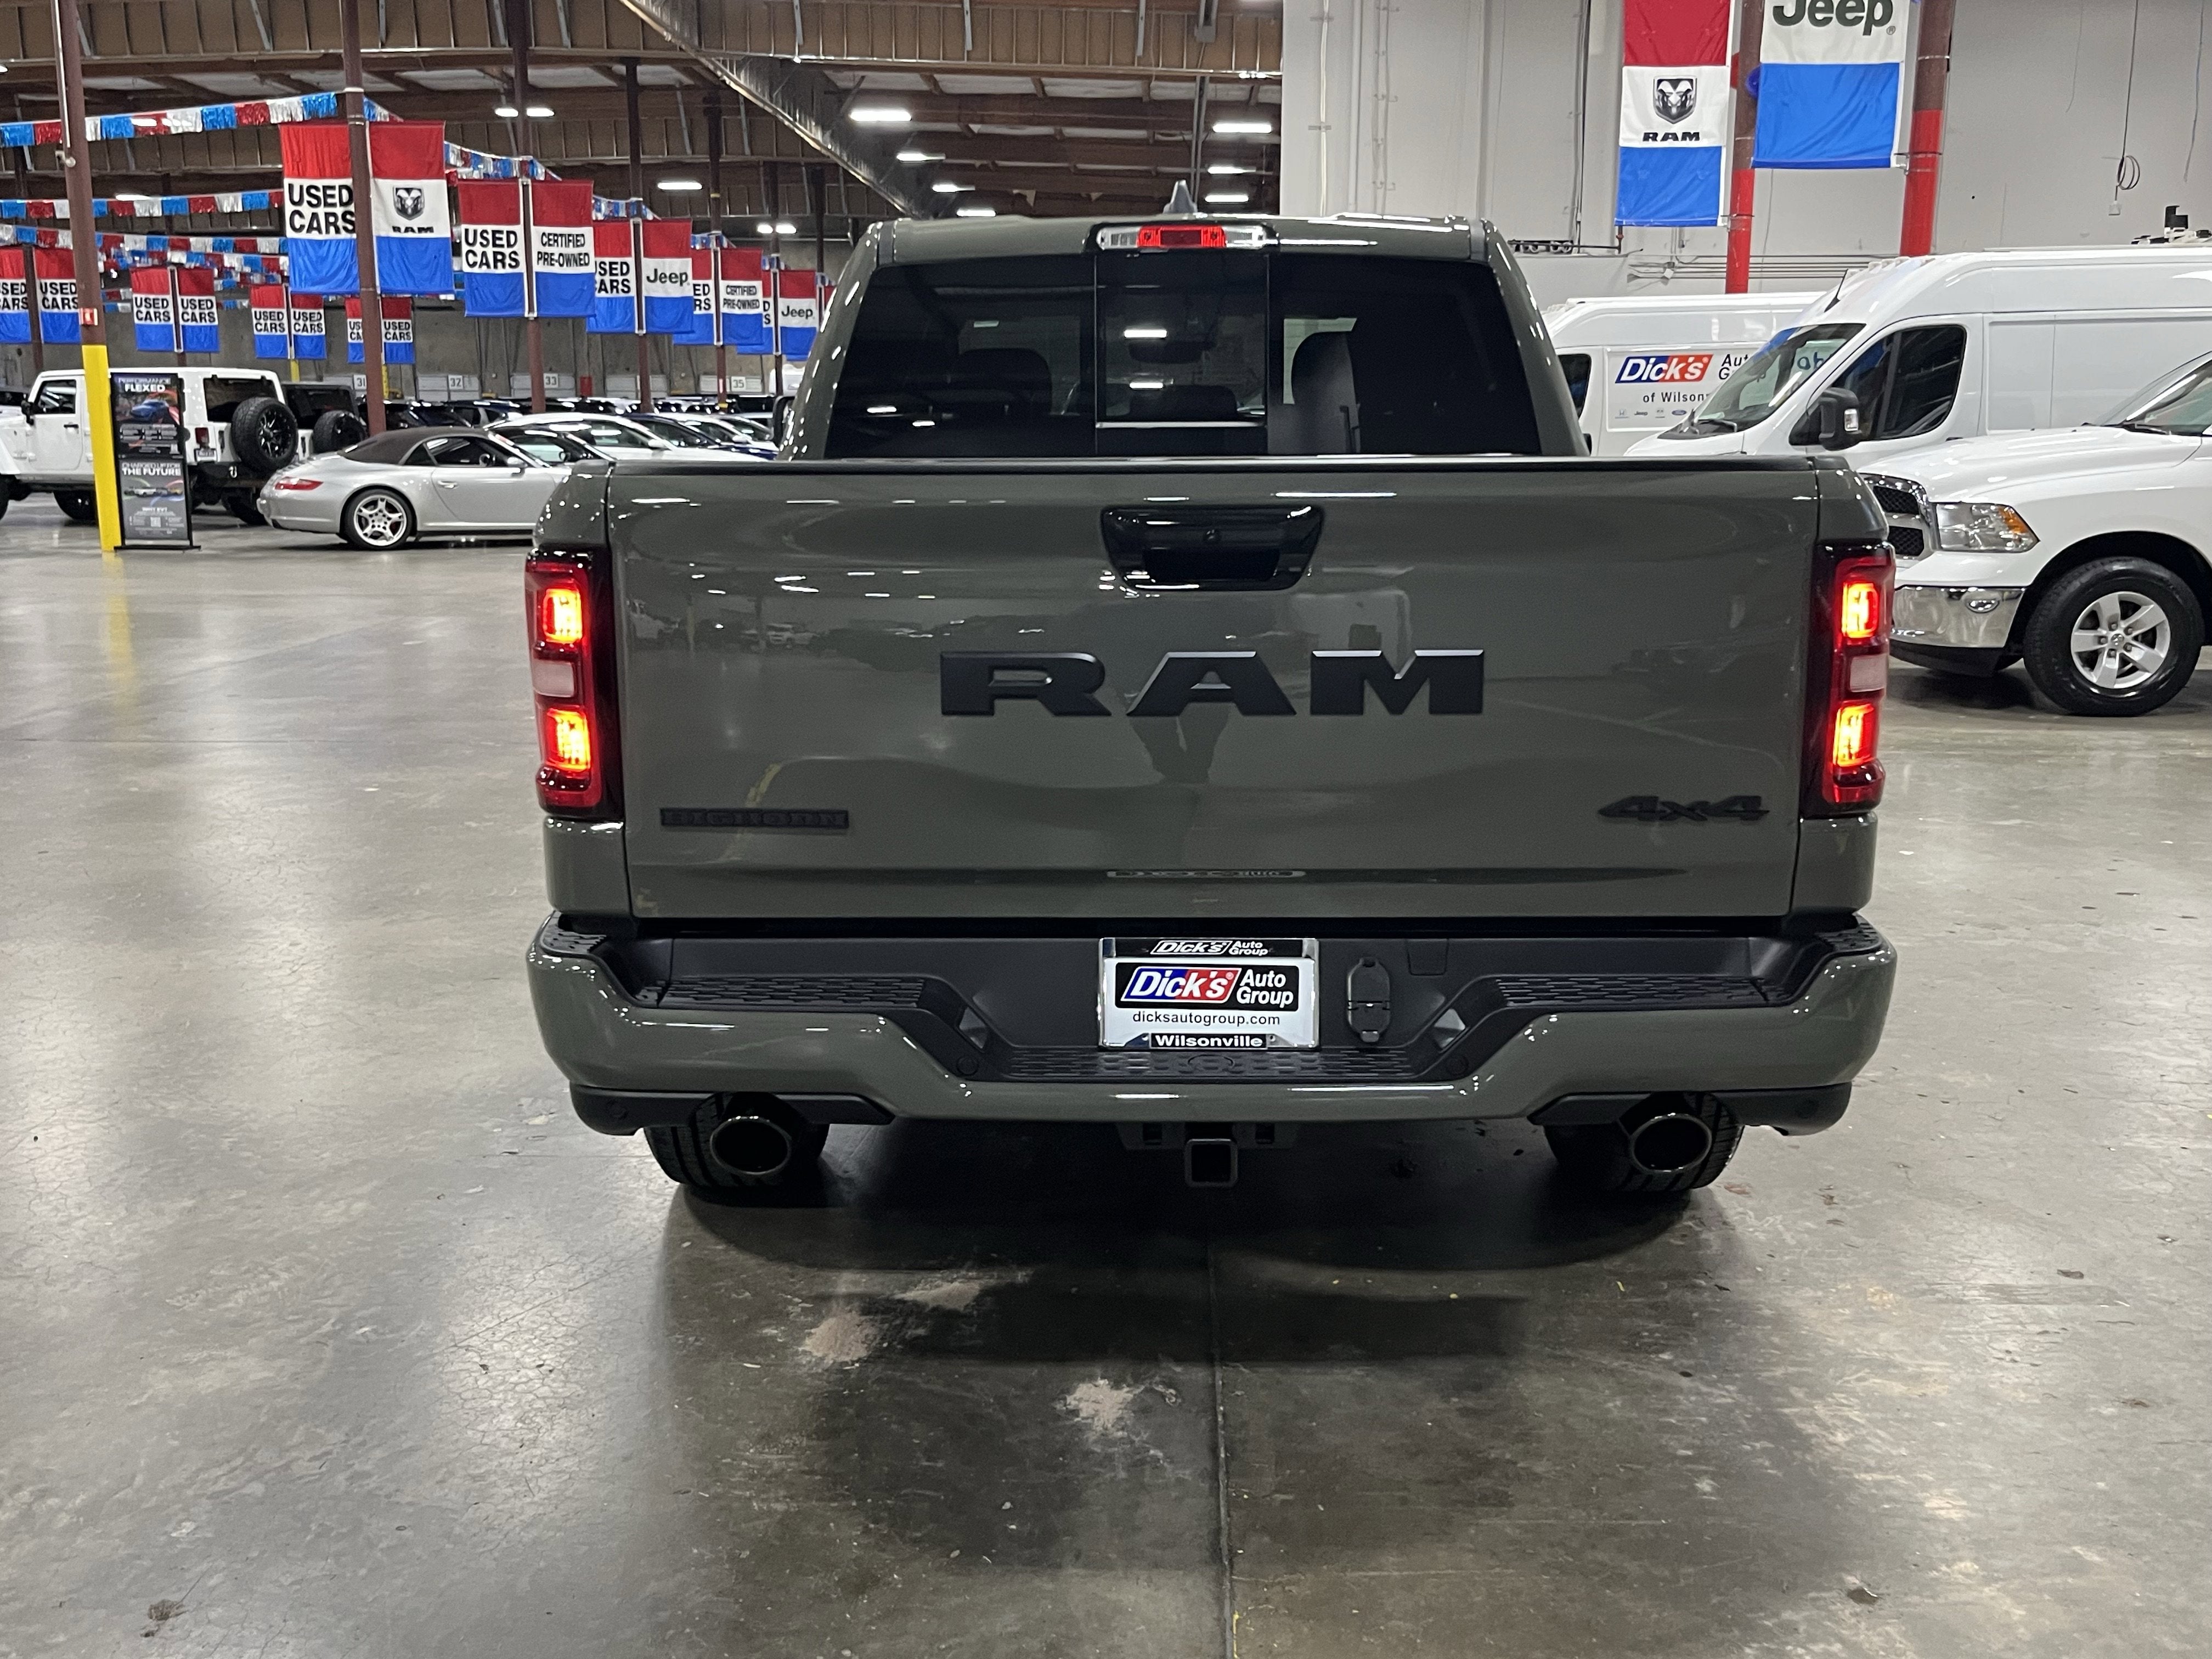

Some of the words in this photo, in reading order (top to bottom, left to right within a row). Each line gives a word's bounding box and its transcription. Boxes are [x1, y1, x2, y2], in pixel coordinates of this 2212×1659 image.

[1773, 0, 1894, 36] Jeep
[1642, 132, 1700, 142] RAM
[288, 183, 353, 208] USED
[289, 210, 356, 234] CARS
[392, 225, 434, 234] RAM
[465, 228, 517, 249] USED
[541, 232, 585, 248] CERTIFIED
[465, 250, 520, 269] CARS
[537, 251, 590, 267] PRE-OWNED
[595, 261, 630, 276] SED
[646, 268, 688, 286] Jeep
[0, 283, 26, 295] SED
[40, 283, 77, 295] USED
[595, 279, 631, 294] ARS
[693, 284, 710, 296] ED
[726, 285, 757, 296] CERTIFIED
[0, 297, 28, 310] ARS
[42, 297, 78, 310] CARS
[134, 297, 169, 309] USED
[180, 298, 213, 310] USED
[693, 298, 711, 311] RS
[723, 298, 759, 309] PRE-OWNED
[136, 310, 171, 322] CARS
[182, 312, 216, 323] CARS
[254, 311, 284, 321] USED
[293, 311, 322, 322] USED
[781, 306, 813, 319] Jeep
[255, 323, 285, 333] CARS
[294, 323, 323, 334] CARS
[349, 321, 362, 330] US
[385, 321, 410, 330] USED
[350, 332, 362, 341] CA
[385, 331, 411, 341] CARS
[1721, 354, 1749, 366] Aut
[1620, 357, 1703, 381] Dick's
[357, 378, 365, 387] 31
[450, 377, 461, 387] 32
[546, 376, 557, 386] 33
[733, 379, 744, 388] 35
[125, 384, 166, 392] FLEXED
[1643, 393, 1655, 403] of
[1661, 392, 1707, 402] Wilson
[941, 650, 1484, 716] RAM
[1158, 941, 1227, 953] Dick's
[1228, 947, 1268, 956] Group
[1130, 970, 1229, 998] Dick's
[1239, 969, 1286, 988] Auto
[1237, 987, 1294, 1008] Group
[1133, 1011, 1280, 1026] dicksautogroup.com
[1155, 1035, 1263, 1047] Wilsonville
